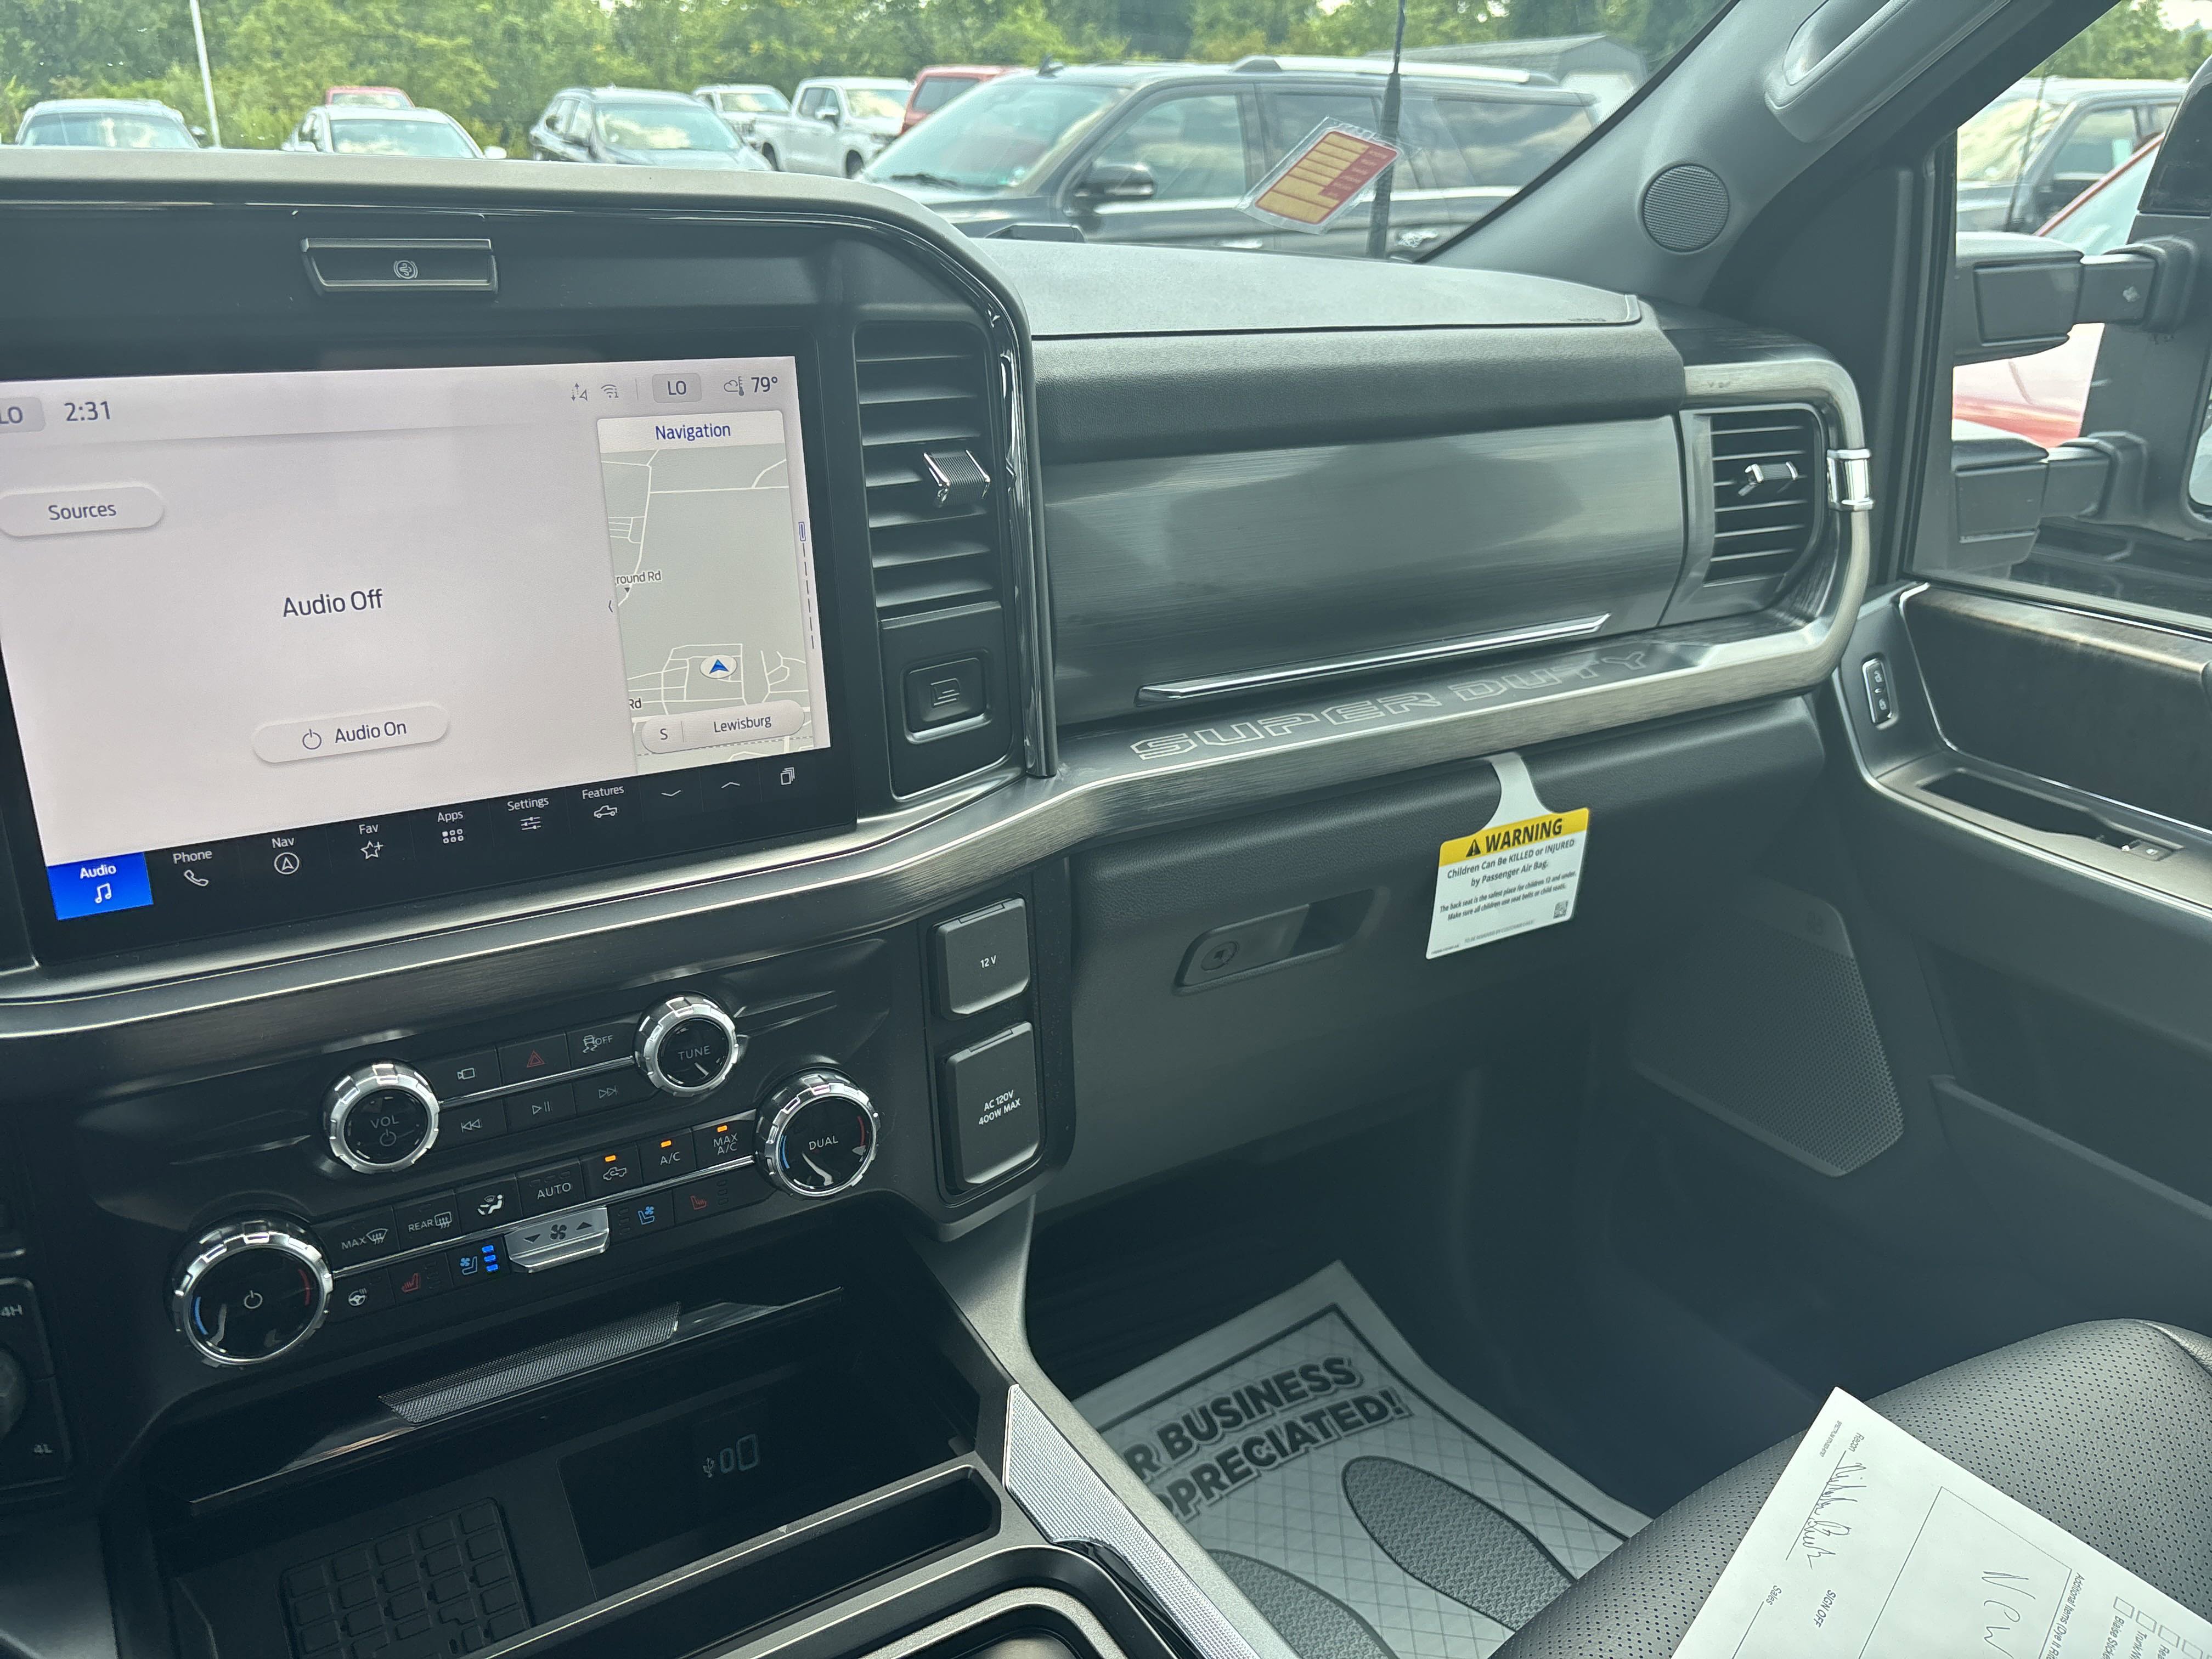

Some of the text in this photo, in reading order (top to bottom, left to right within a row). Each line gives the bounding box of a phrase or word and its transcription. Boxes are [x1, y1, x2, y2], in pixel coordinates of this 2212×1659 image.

[668, 381, 687, 396] LO
[751, 376, 778, 393] 79°
[64, 401, 111, 422] 2:31
[656, 424, 731, 441] Navigation
[48, 503, 117, 521] Sources
[615, 571, 662, 584] round Rd
[283, 589, 382, 617] Audio Off
[1130, 651, 1646, 761] SUPER DUTY
[335, 721, 407, 744] Audio On
[714, 716, 771, 733] Lewisburg
[660, 729, 668, 740] S
[582, 785, 624, 799] Features
[507, 796, 549, 811] Settings
[437, 809, 464, 823] Apps
[359, 823, 379, 835] Fav
[1486, 818, 1563, 854] WARNING
[272, 837, 295, 849] Nav
[173, 848, 212, 864] Phone
[1447, 864, 1480, 879] Children
[1481, 860, 1496, 871] Can
[1509, 849, 1534, 863] KILLED
[1545, 838, 1575, 854] INJURED
[80, 863, 117, 879] Audio
[1471, 860, 1548, 887] by Passenger Air Bag.
[1450, 901, 1462, 910] back
[1463, 899, 1473, 907] seat
[1488, 890, 1503, 899] safest
[1503, 888, 1516, 897] place
[1525, 880, 1544, 889] children
[1551, 873, 1561, 882] and
[1448, 912, 1462, 921] Make
[1463, 909, 1473, 917] sure
[1481, 901, 1500, 911] children
[1511, 895, 1521, 903] seat
[1522, 891, 1533, 900] belts
[1541, 886, 1552, 895] child
[980, 955, 997, 968] 12 V
[595, 1035, 613, 1046] OFF
[678, 1046, 711, 1061] TUNE
[984, 1090, 1014, 1112] AC 120V
[979, 1098, 1021, 1126] 400W MAX
[370, 1115, 399, 1130] VOL
[713, 1133, 738, 1148] MAX
[717, 1142, 738, 1155] A/C
[809, 1135, 839, 1150] DUAL
[659, 1152, 681, 1166] A/C
[537, 1182, 572, 1200] AUTO
[408, 1219, 433, 1233] REAR
[341, 1237, 367, 1250] MAX
[1124, 1357, 1357, 1482] R BUSINESS
[1848, 1432, 1865, 1452] Recon
[1766, 1585, 1782, 1605] Sales
[2067, 1572, 2085, 1607] Additional
[1813, 1589, 1836, 1628] SIGN OFF
[2060, 1604, 2074, 1624] Items
[2053, 1622, 2067, 1641] (Dye
[2110, 1615, 2125, 1638] Blaise
